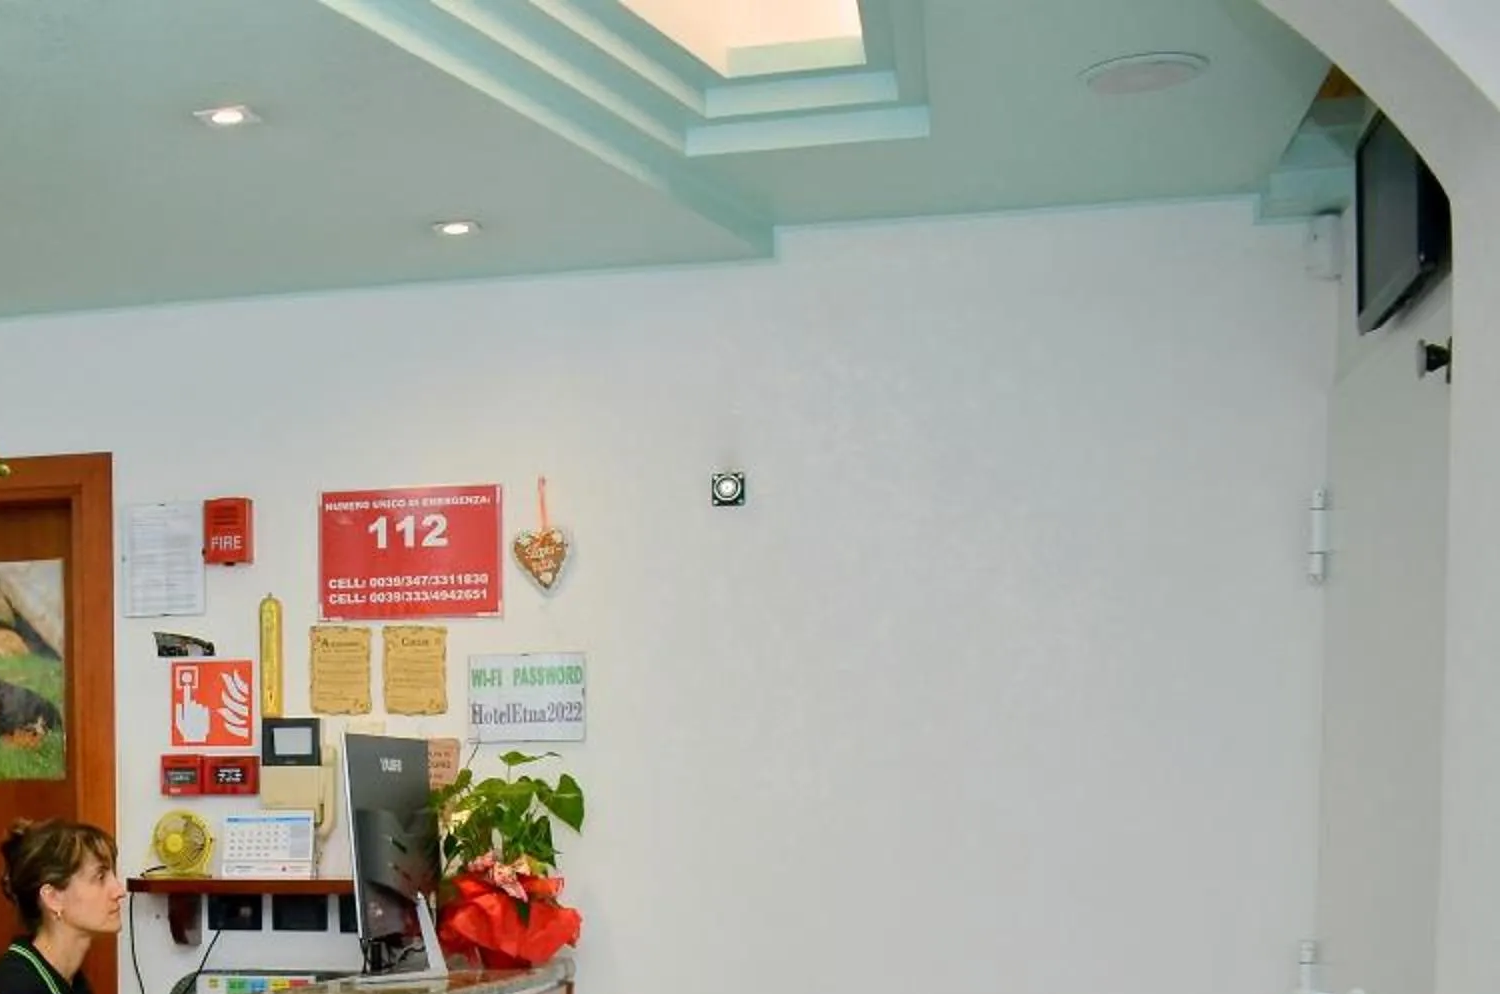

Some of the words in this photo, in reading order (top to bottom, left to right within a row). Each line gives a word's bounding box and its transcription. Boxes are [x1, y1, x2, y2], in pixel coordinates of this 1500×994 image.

[367, 514, 449, 549] 112
[211, 535, 244, 551] FIRE
[328, 578, 366, 589] CELL:
[328, 594, 366, 605] CELL:
[471, 668, 502, 688] WI-FI
[513, 665, 583, 687] PASSWORD
[471, 700, 583, 724] HotelEtna2022
